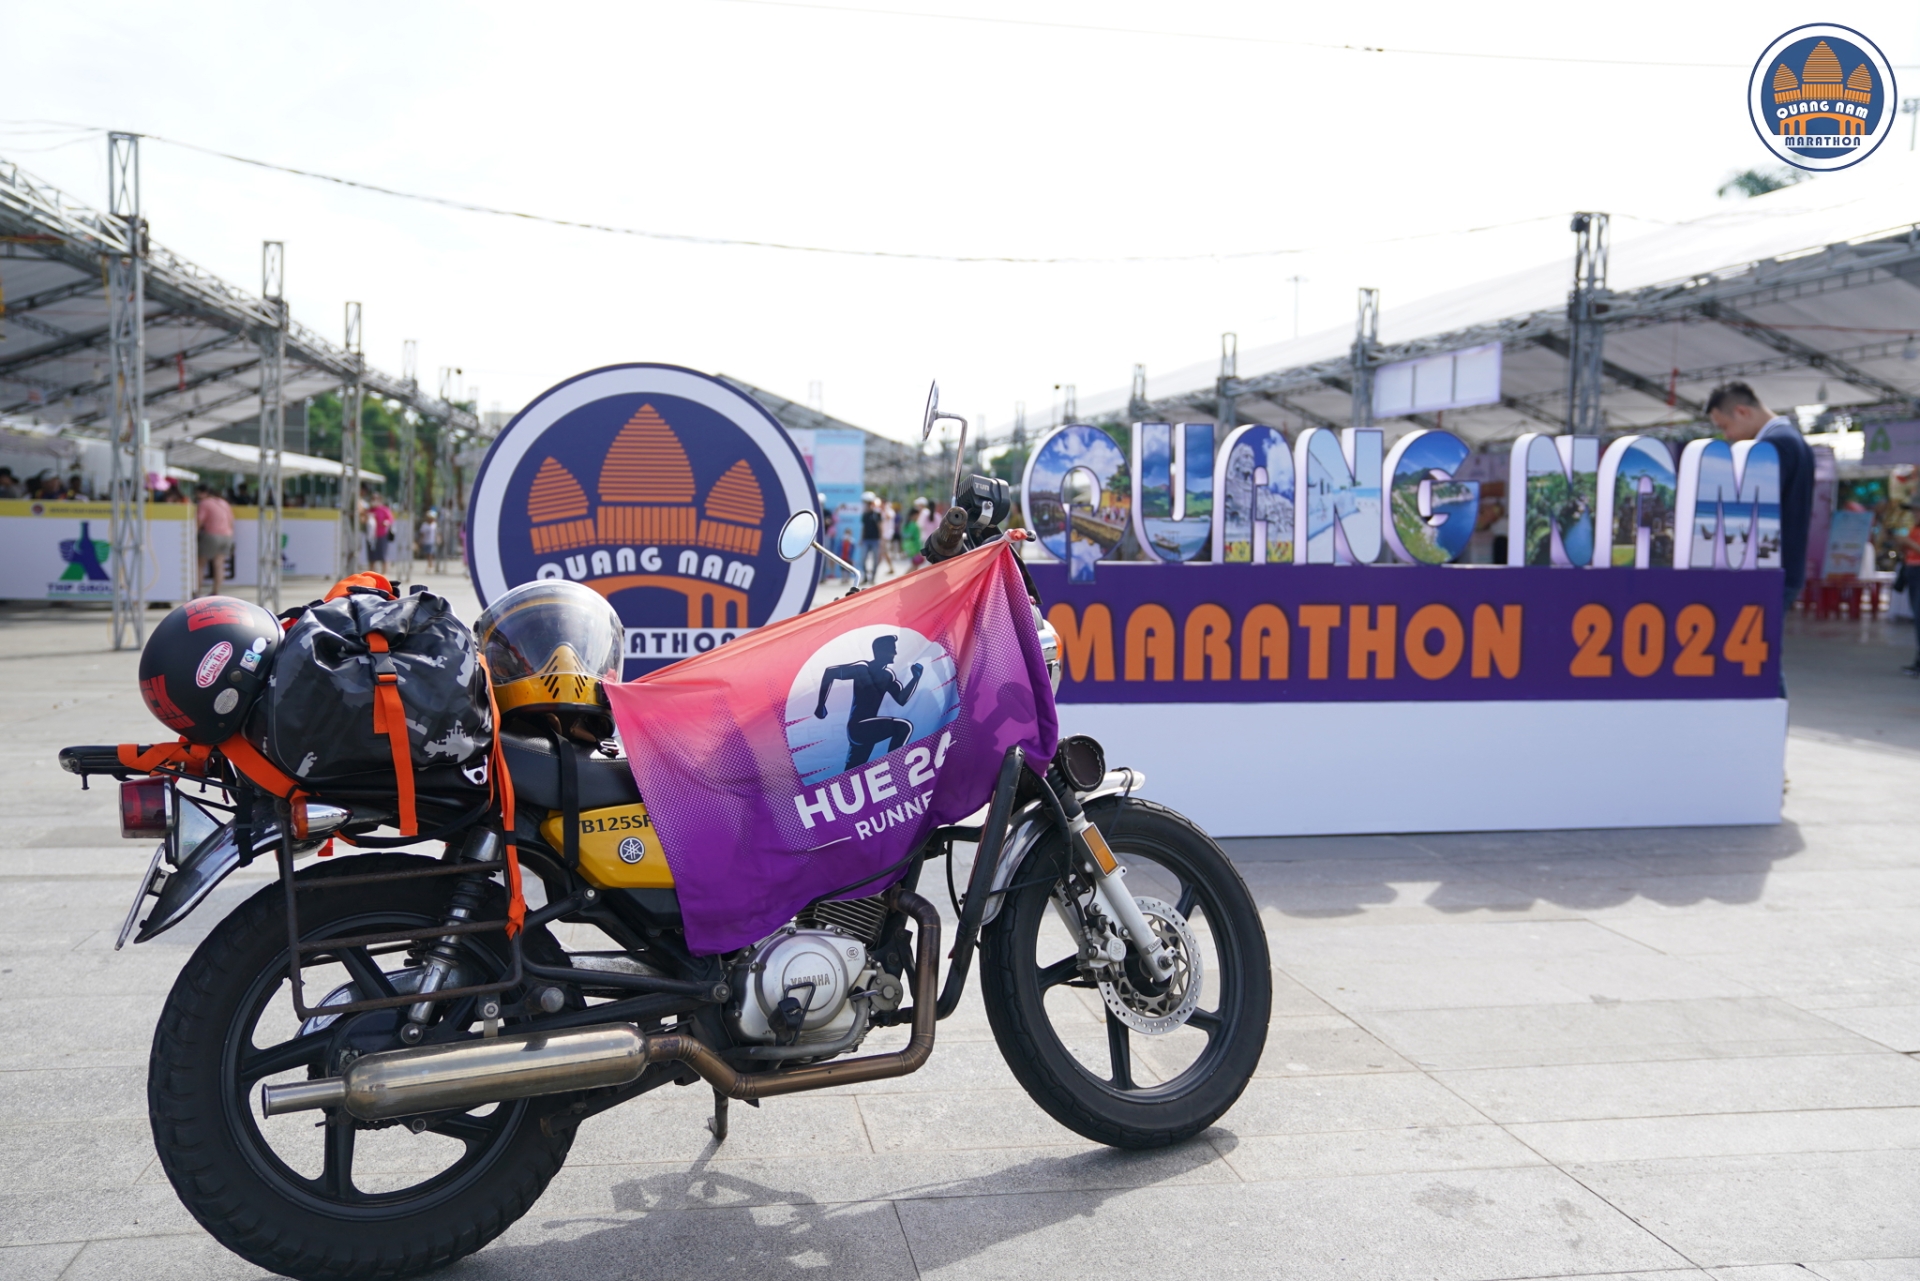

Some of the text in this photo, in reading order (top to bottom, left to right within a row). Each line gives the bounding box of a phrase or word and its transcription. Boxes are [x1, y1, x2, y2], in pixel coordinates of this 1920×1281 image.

[1021, 421, 1782, 584] QUANG NAM
[536, 546, 756, 590] QUANG NAM
[1047, 602, 1769, 683] MARATHON 2024
[793, 761, 898, 830] HUE
